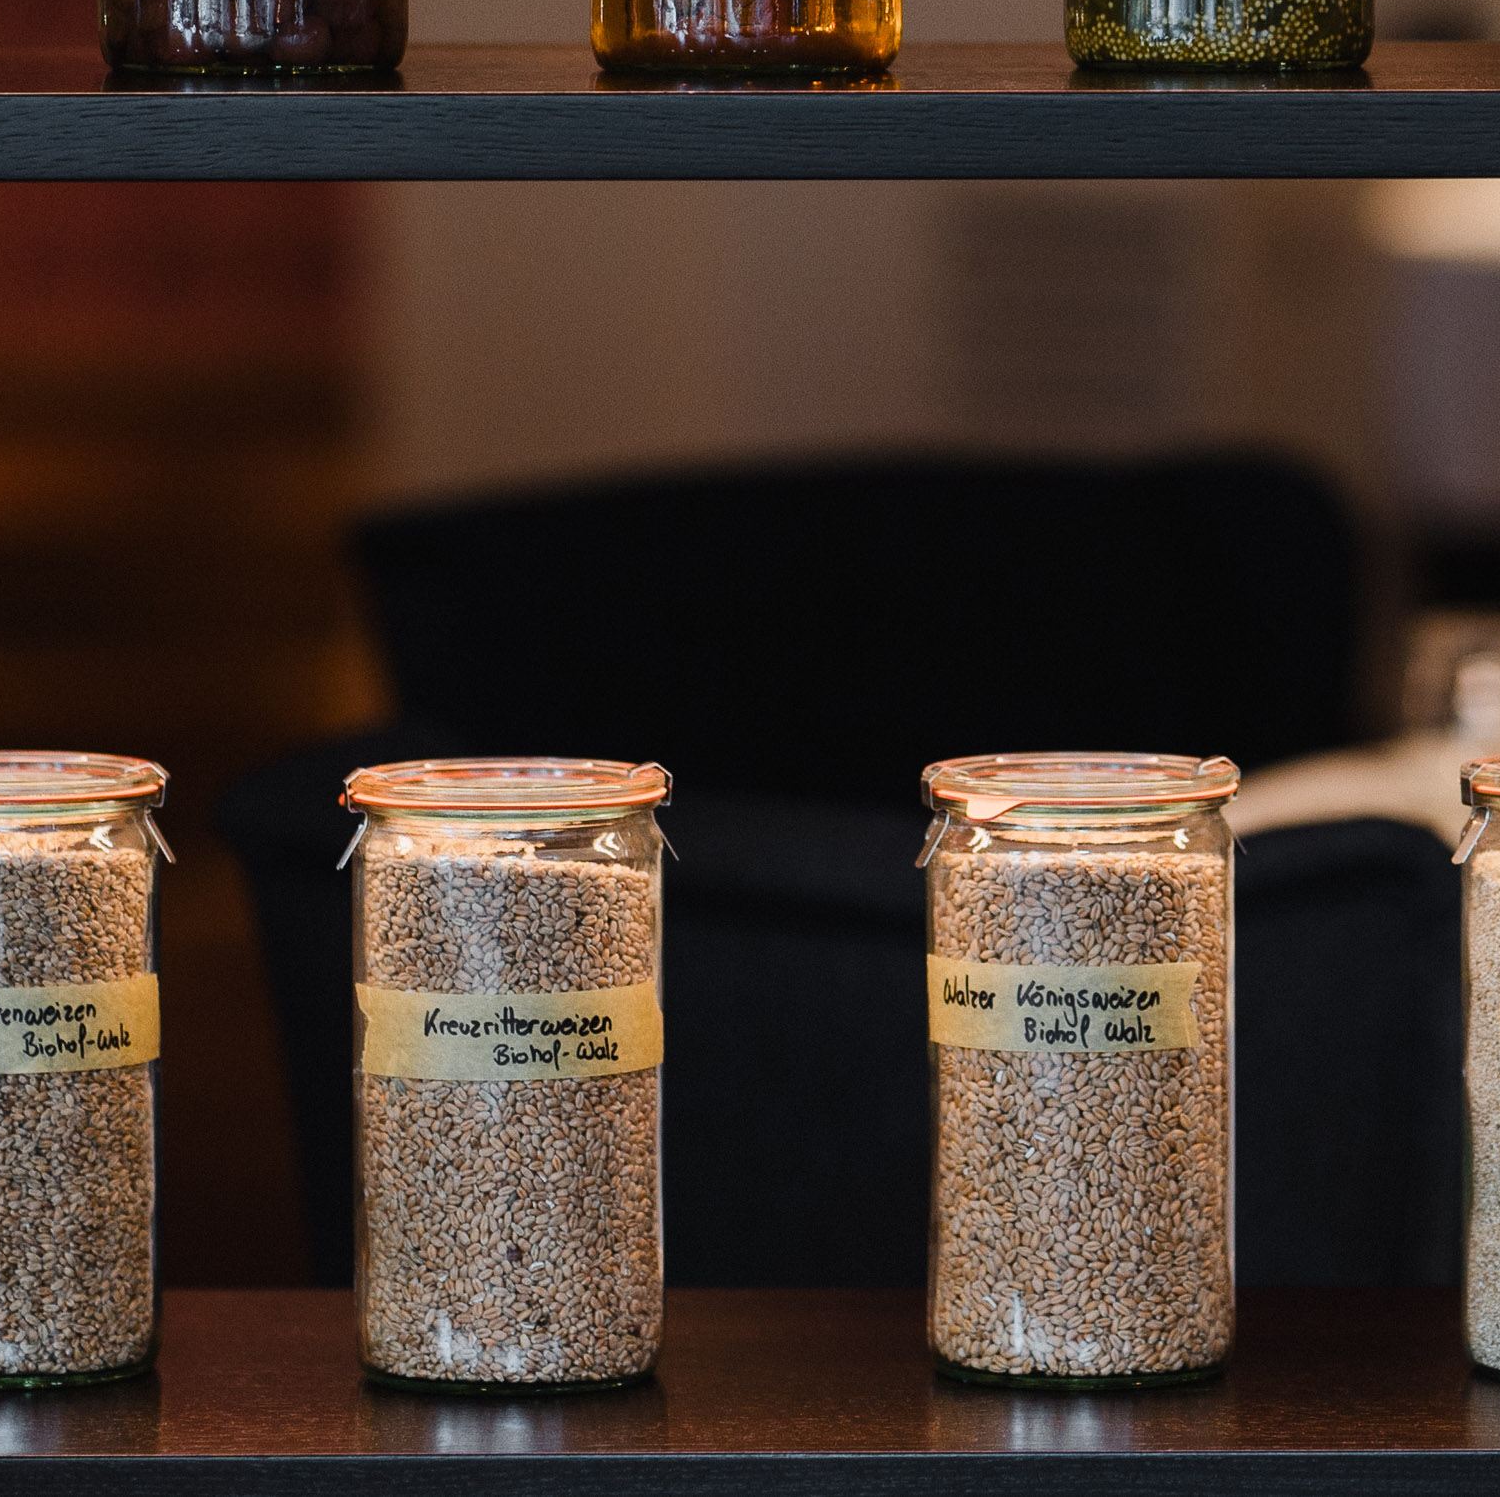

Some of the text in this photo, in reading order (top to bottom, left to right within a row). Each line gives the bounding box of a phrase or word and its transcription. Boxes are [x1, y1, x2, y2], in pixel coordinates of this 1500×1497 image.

[943, 974, 1160, 1028] Walzer Königsweizen
[424, 1006, 612, 1037] Kreuzritterweizen
[1024, 1014, 1156, 1048] Biohof Walz
